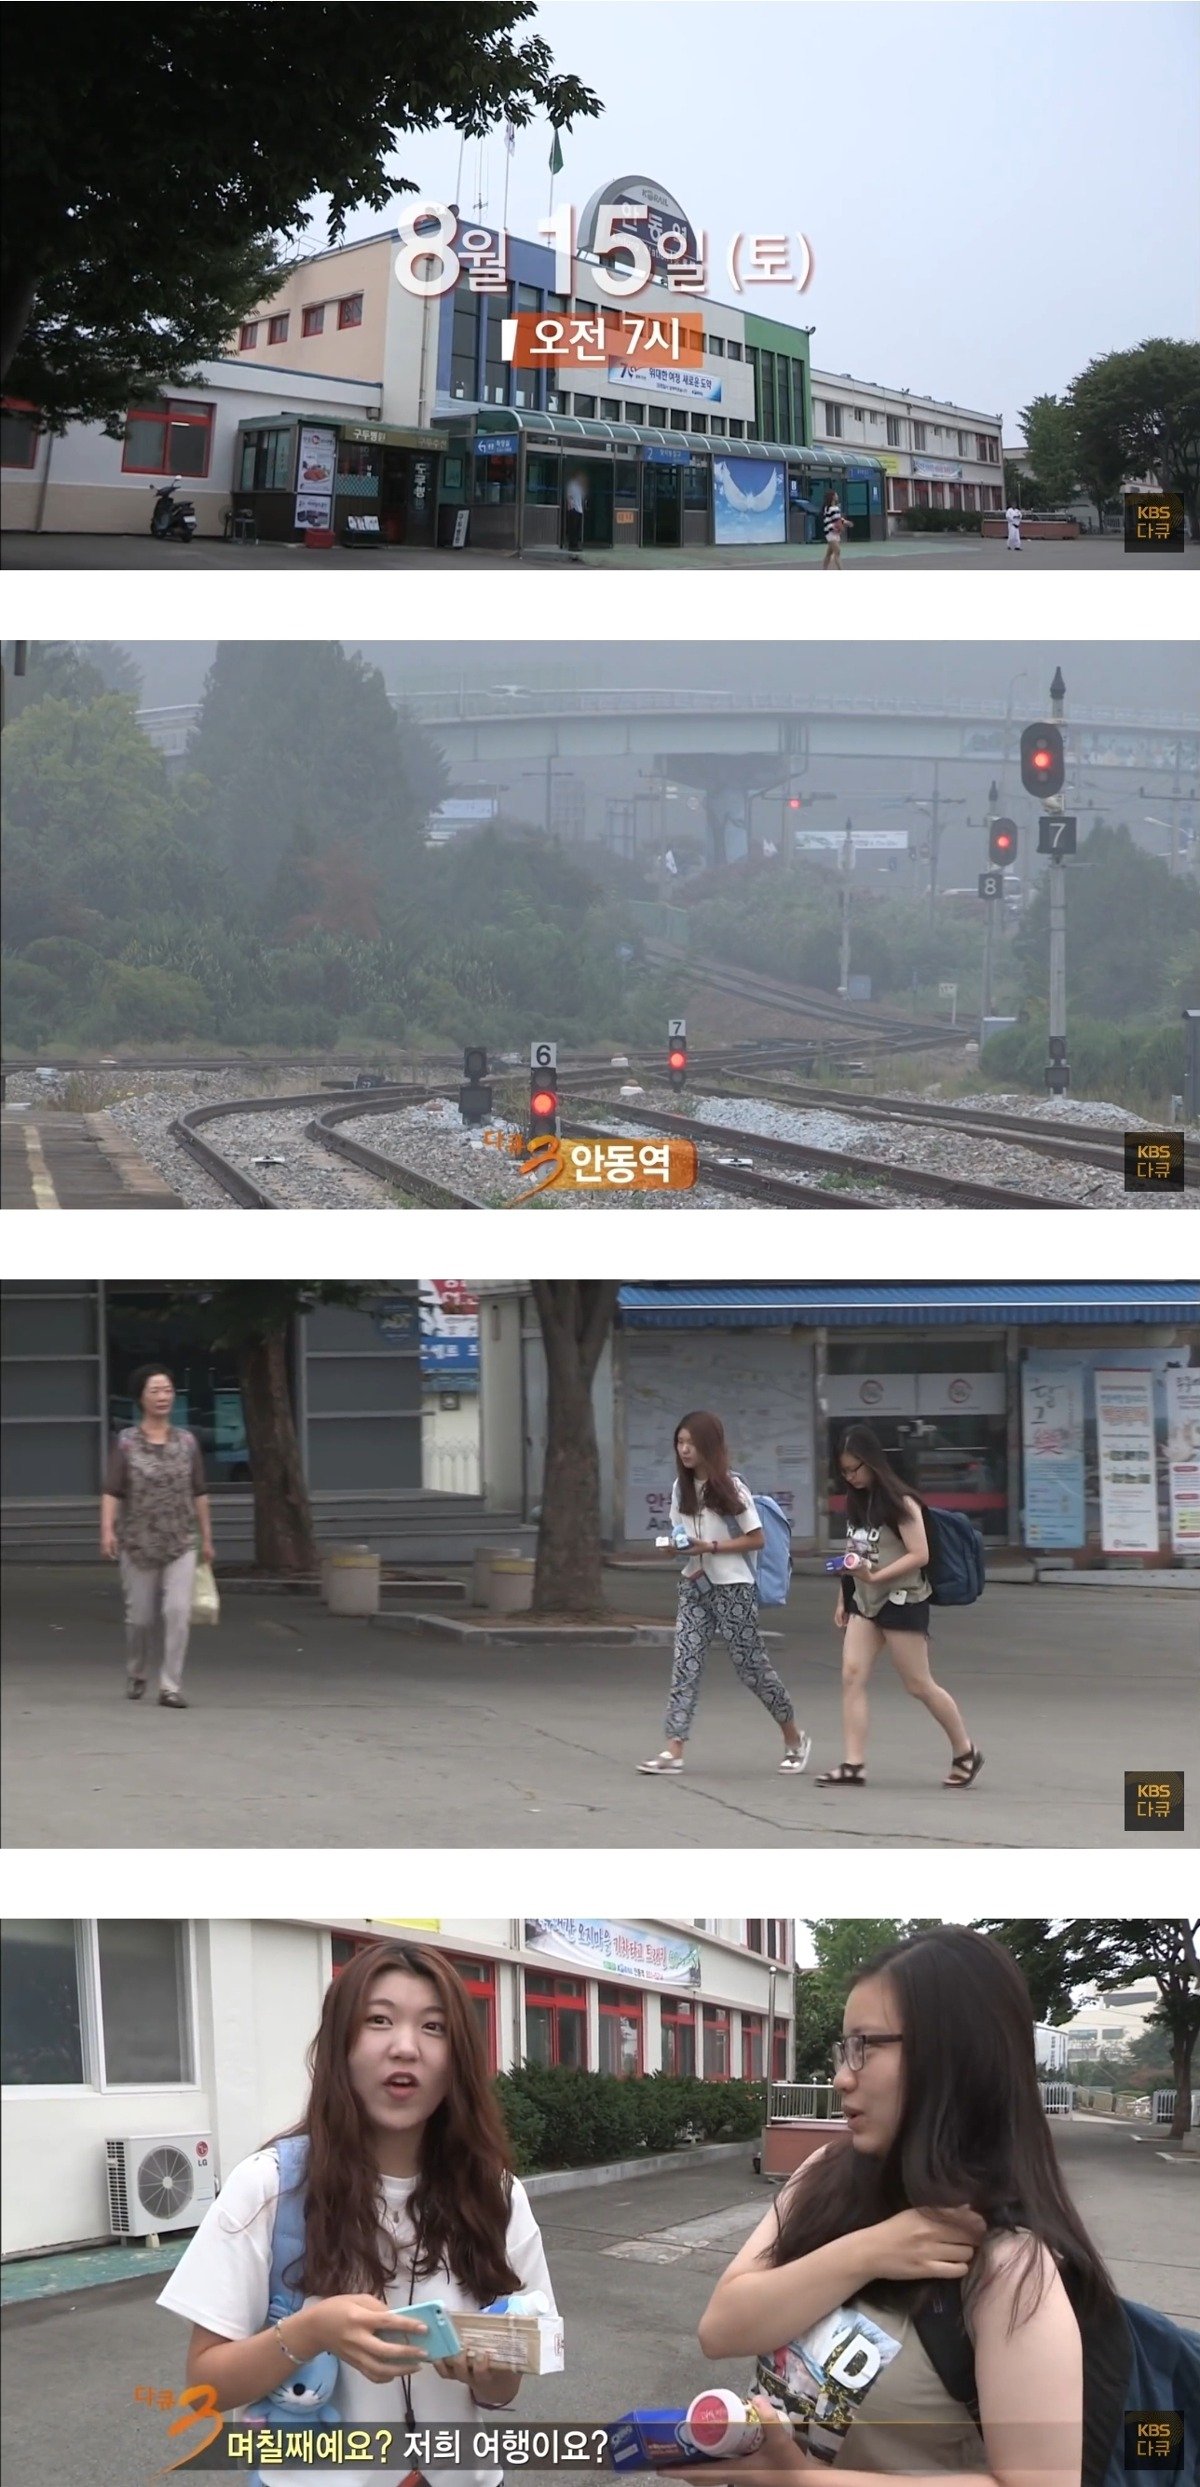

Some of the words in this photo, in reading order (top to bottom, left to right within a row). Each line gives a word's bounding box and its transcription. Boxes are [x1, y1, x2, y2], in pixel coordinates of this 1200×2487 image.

[649, 367, 667, 381] 위대한
[668, 373, 681, 383] 여정
[682, 375, 699, 388] 새로운
[700, 379, 712, 390] 도약
[353, 428, 386, 442] 구두병원
[1049, 823, 1066, 848] 7
[984, 878, 997, 895] 8
[673, 1021, 682, 1035] 7
[536, 1044, 551, 1066] 6
[198, 2159, 208, 2167] LG
